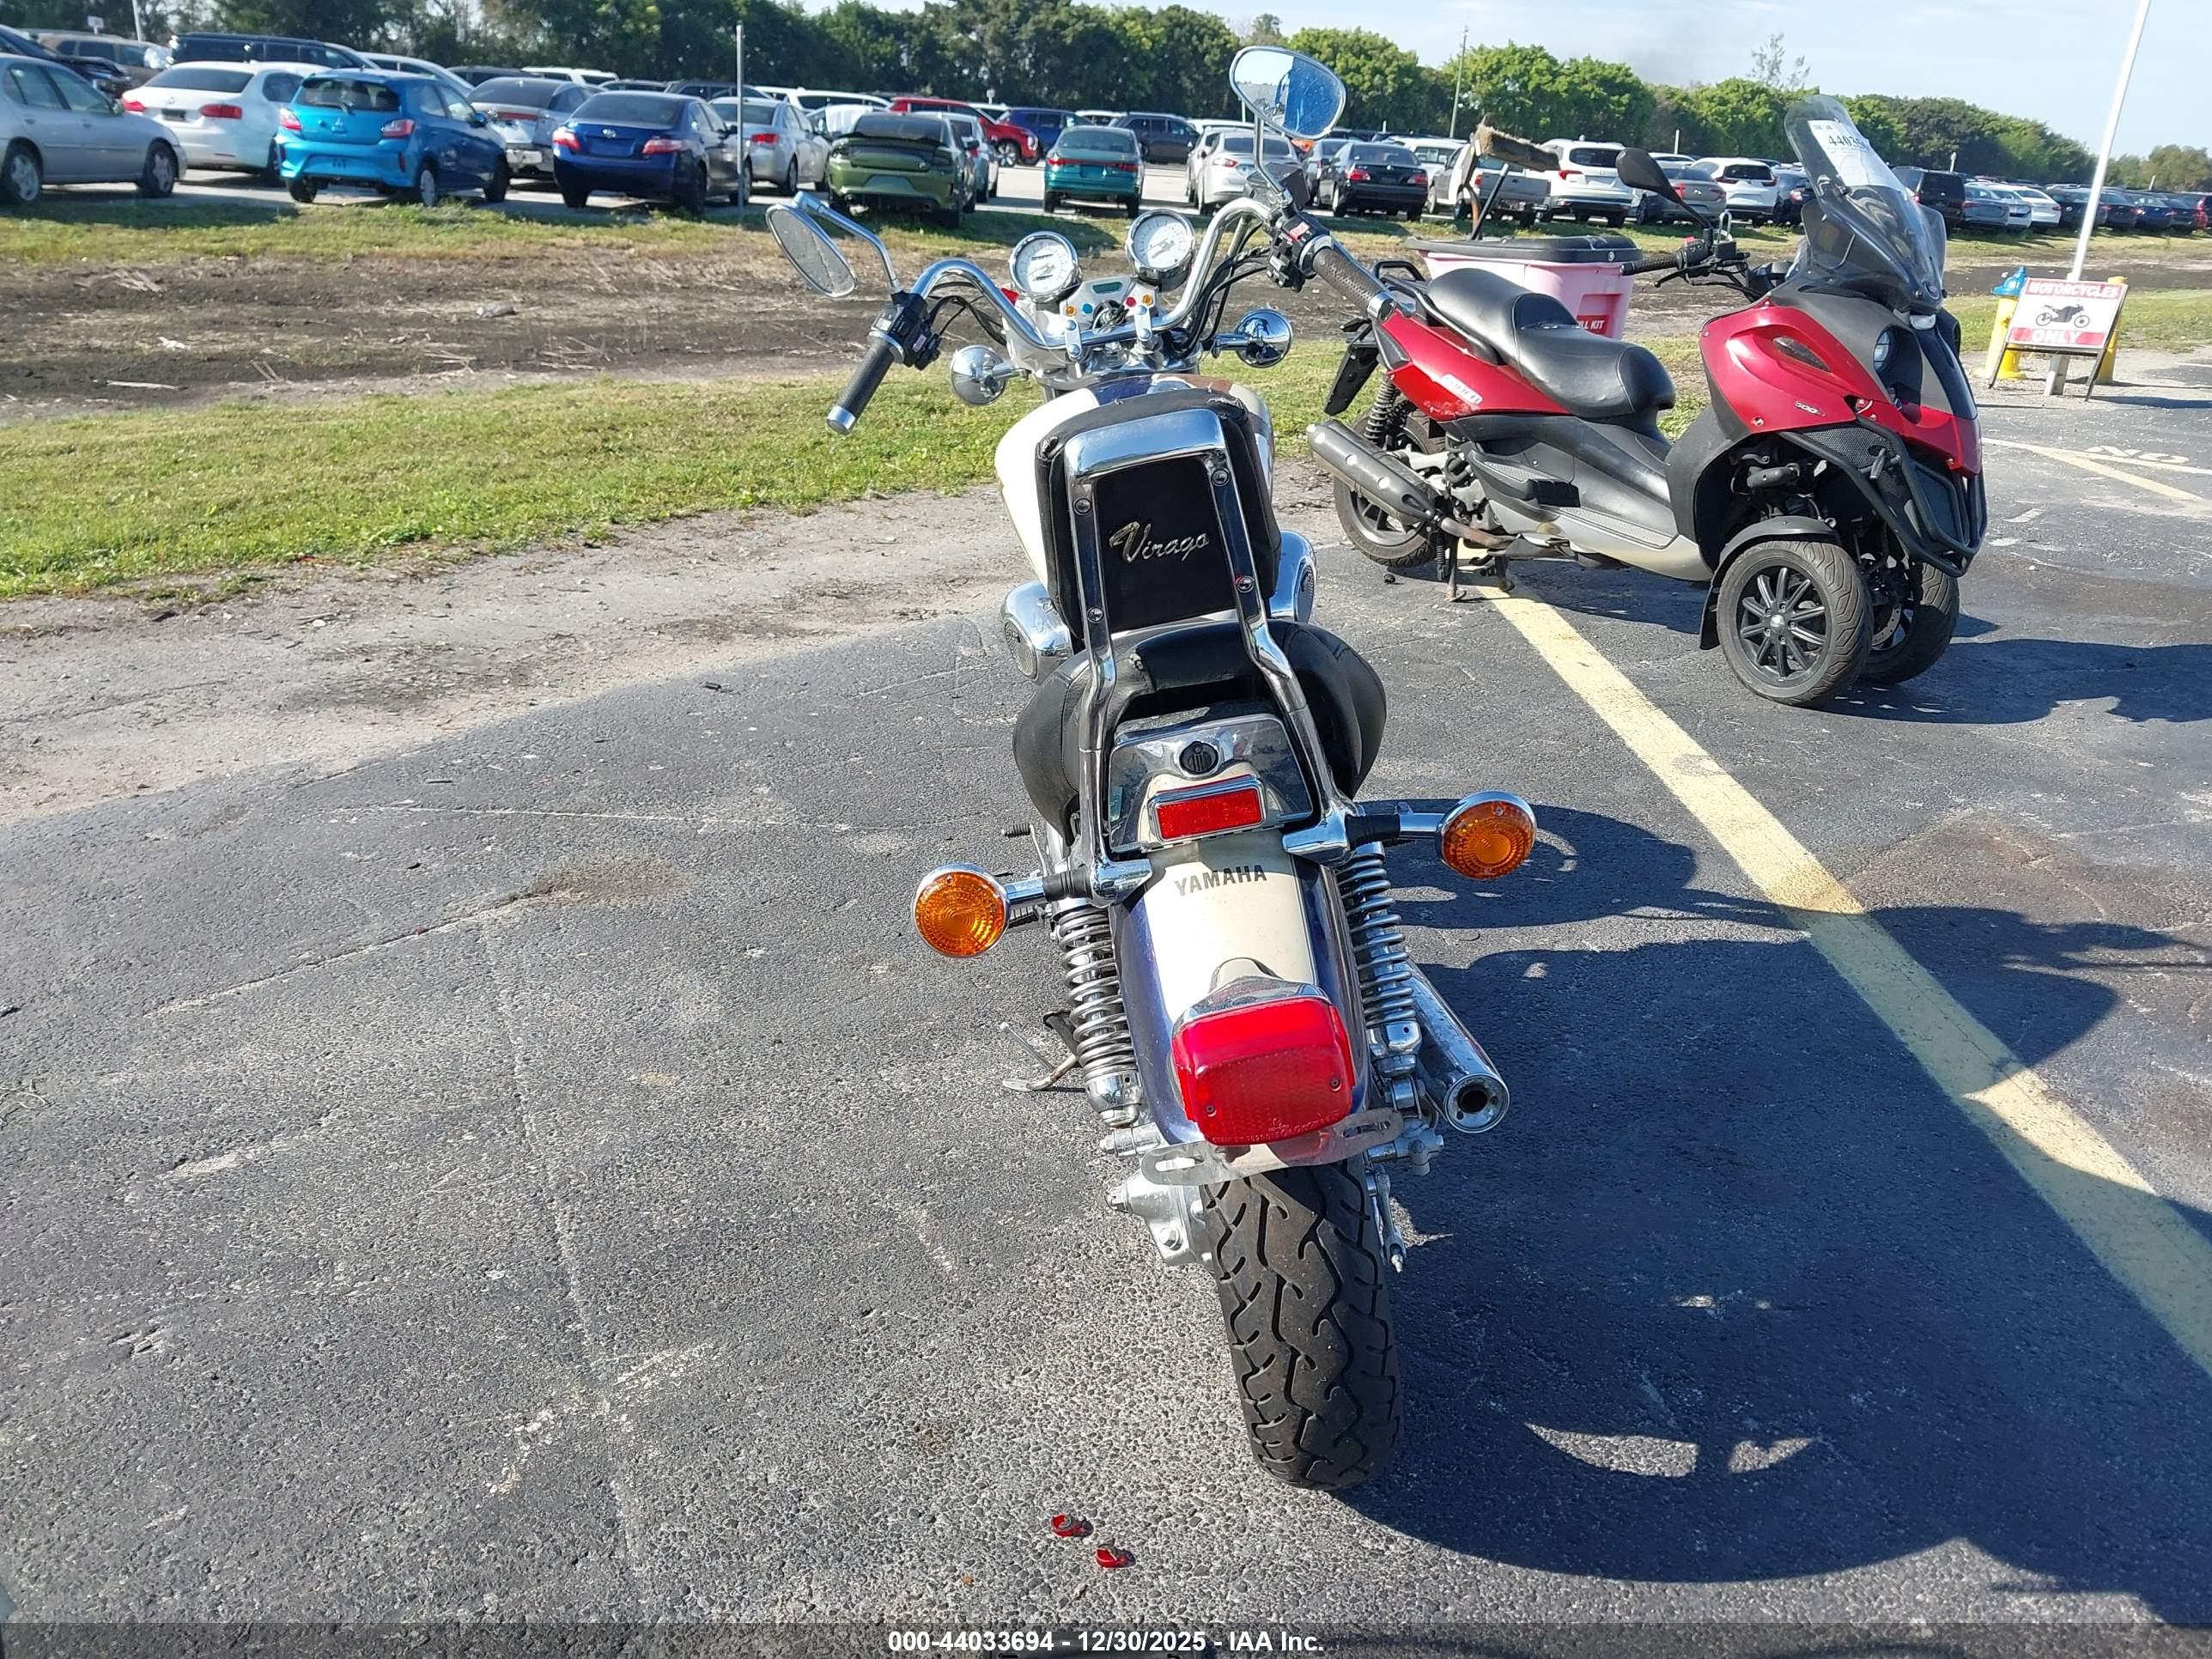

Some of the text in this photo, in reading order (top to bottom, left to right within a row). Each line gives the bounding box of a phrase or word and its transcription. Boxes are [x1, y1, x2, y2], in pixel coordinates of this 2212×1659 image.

[2027, 281, 2122, 299] MOTORCYCLES
[1590, 319, 1605, 330] KIT
[2032, 328, 2082, 344] ONLY
[1109, 520, 1210, 563] Virago
[1174, 864, 1268, 896] YAMAHA
